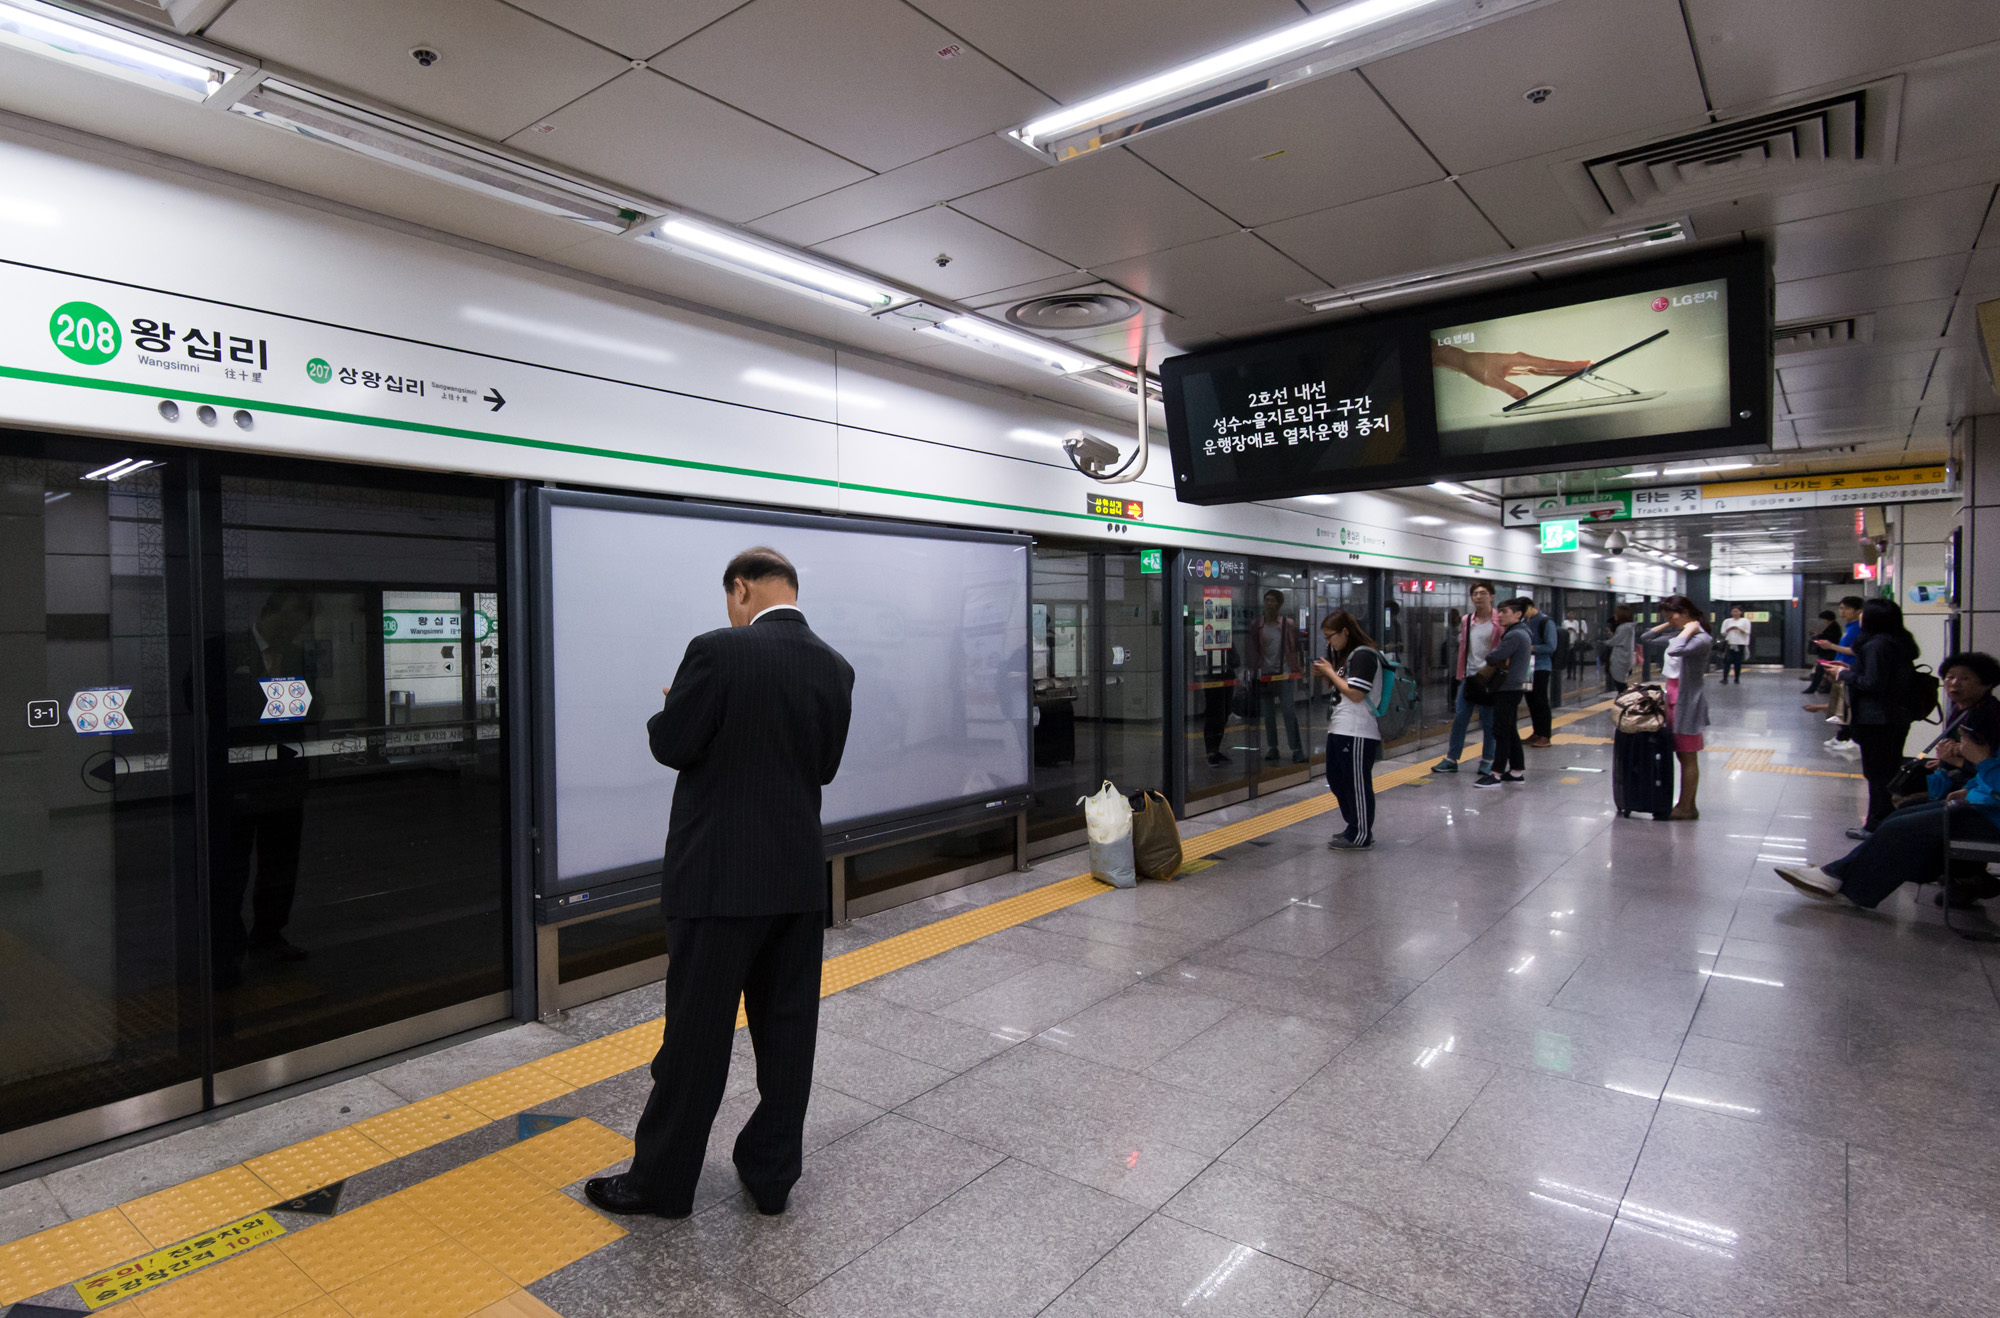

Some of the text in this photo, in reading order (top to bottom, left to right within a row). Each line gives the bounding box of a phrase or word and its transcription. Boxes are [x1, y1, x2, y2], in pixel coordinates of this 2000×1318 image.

[1672, 290, 1719, 306] LG전자
[56, 314, 268, 370] 208 왕십리
[1438, 336, 1451, 346] LG
[138, 354, 200, 373] Wangsimni
[224, 368, 262, 383] 往十里
[308, 362, 425, 397] 207 상왕십리
[1248, 380, 1327, 408] 2호선 내선
[1212, 395, 1372, 435] 성수~을지로입구 구간
[1202, 414, 1390, 456] 운행장애로 열차운행 중지
[1774, 478, 1845, 490] 나가는 곳
[1636, 489, 1696, 503] 타는 곳
[1096, 498, 1122, 516] 상왕십리
[418, 616, 459, 626] 왕십리
[34, 708, 54, 719] 3-1
[290, 1189, 332, 1209] 3-1
[84, 1217, 265, 1290] 주의! 전동차와
[96, 1227, 274, 1302] 승강장간격 10 cm
